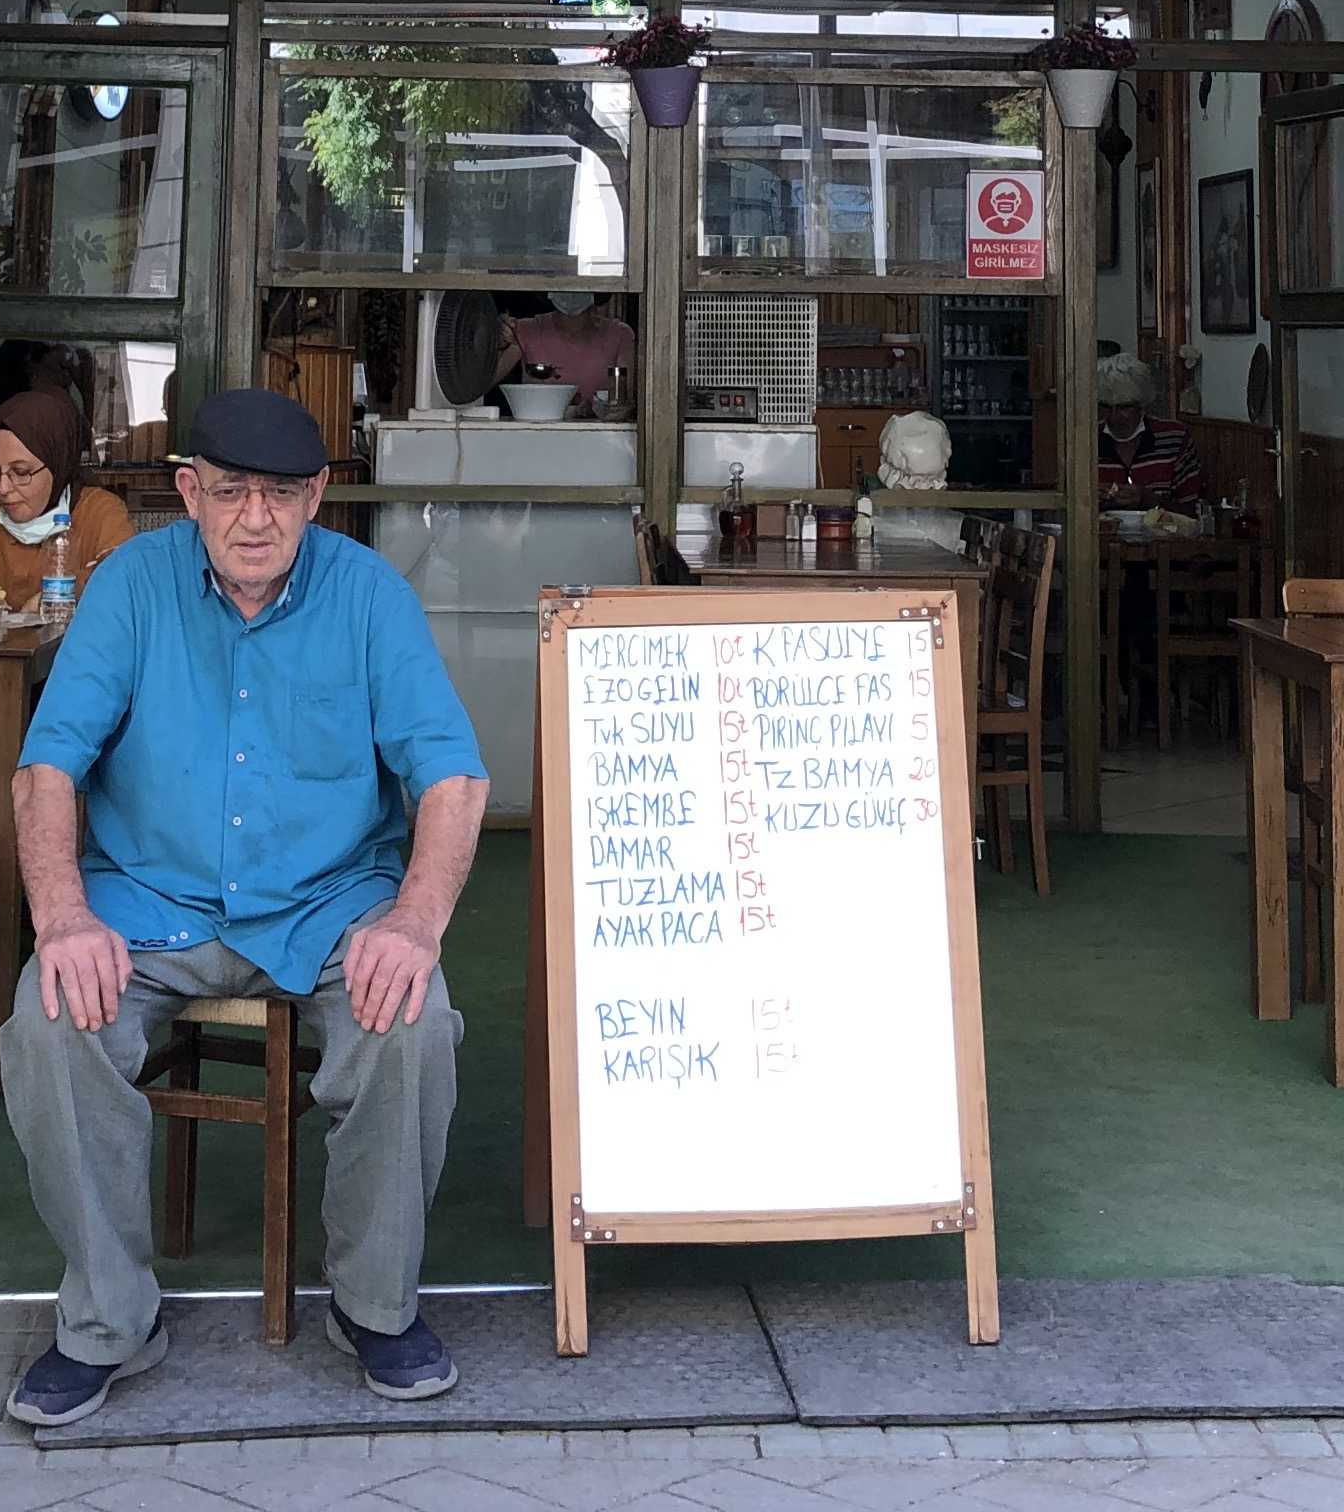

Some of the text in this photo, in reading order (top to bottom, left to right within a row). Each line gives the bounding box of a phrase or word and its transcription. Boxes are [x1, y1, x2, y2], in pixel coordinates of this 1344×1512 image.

[972, 242, 1039, 255] MASKESİZ
[974, 255, 1039, 269] GİRİLMEZ
[855, 672, 892, 705] FAS
[630, 711, 695, 744] SUYU
[587, 751, 679, 787] BAMYA
[803, 758, 894, 790] BAMYA
[908, 756, 936, 781] 20
[764, 800, 840, 833] KUZU
[913, 797, 938, 821] 30
[590, 835, 676, 871] DAMAR
[585, 871, 726, 907] TUZLAMA
[593, 913, 654, 948] AYAK
[595, 996, 685, 1041] BEYIN
[604, 1041, 720, 1090] KARIŞIK
